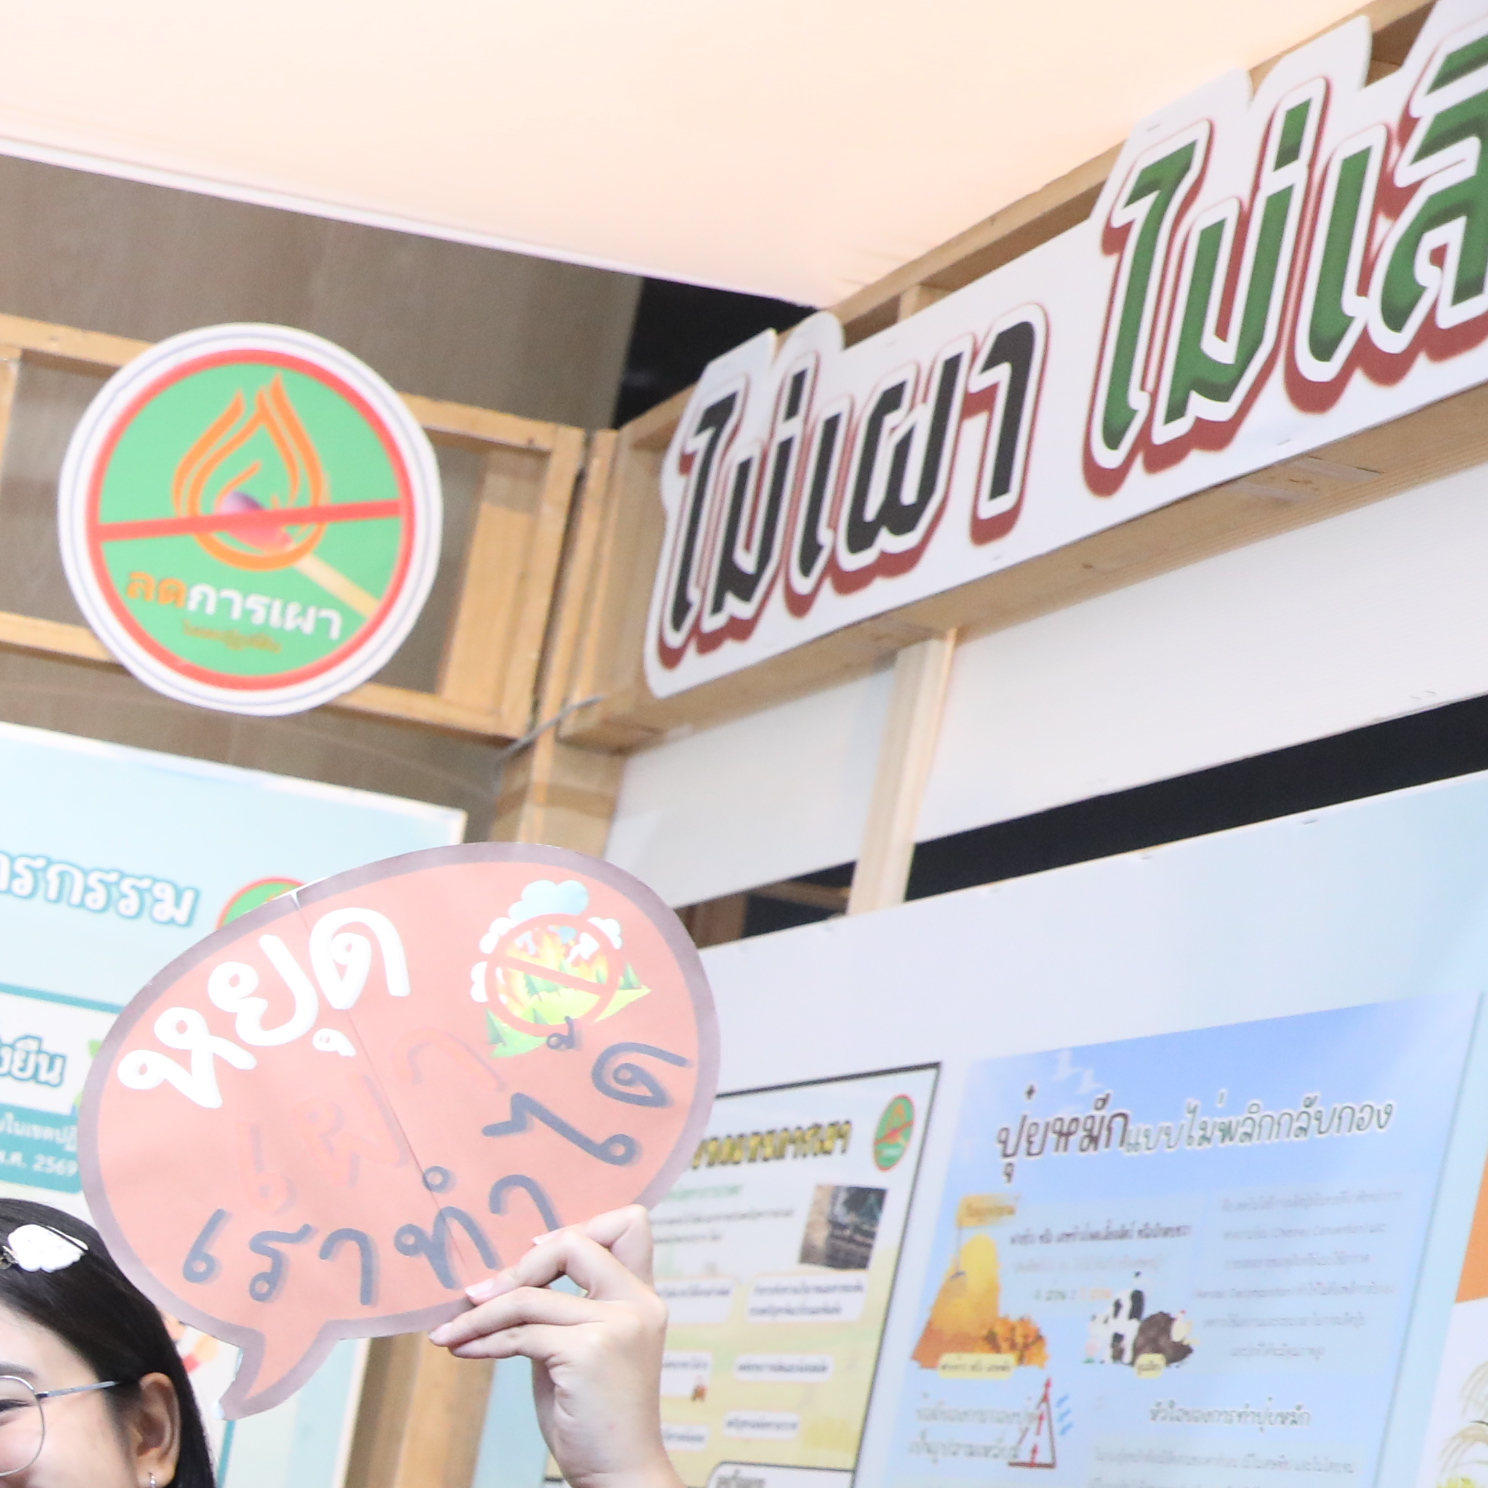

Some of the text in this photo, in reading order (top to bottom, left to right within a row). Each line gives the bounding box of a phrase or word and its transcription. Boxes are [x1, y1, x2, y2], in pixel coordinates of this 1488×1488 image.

[669, 318, 1038, 638] ไม่เผา
[126, 569, 343, 641] ลดการเผา
[117, 906, 413, 1110] หยุด
[181, 1014, 694, 1307] เราทำได้
